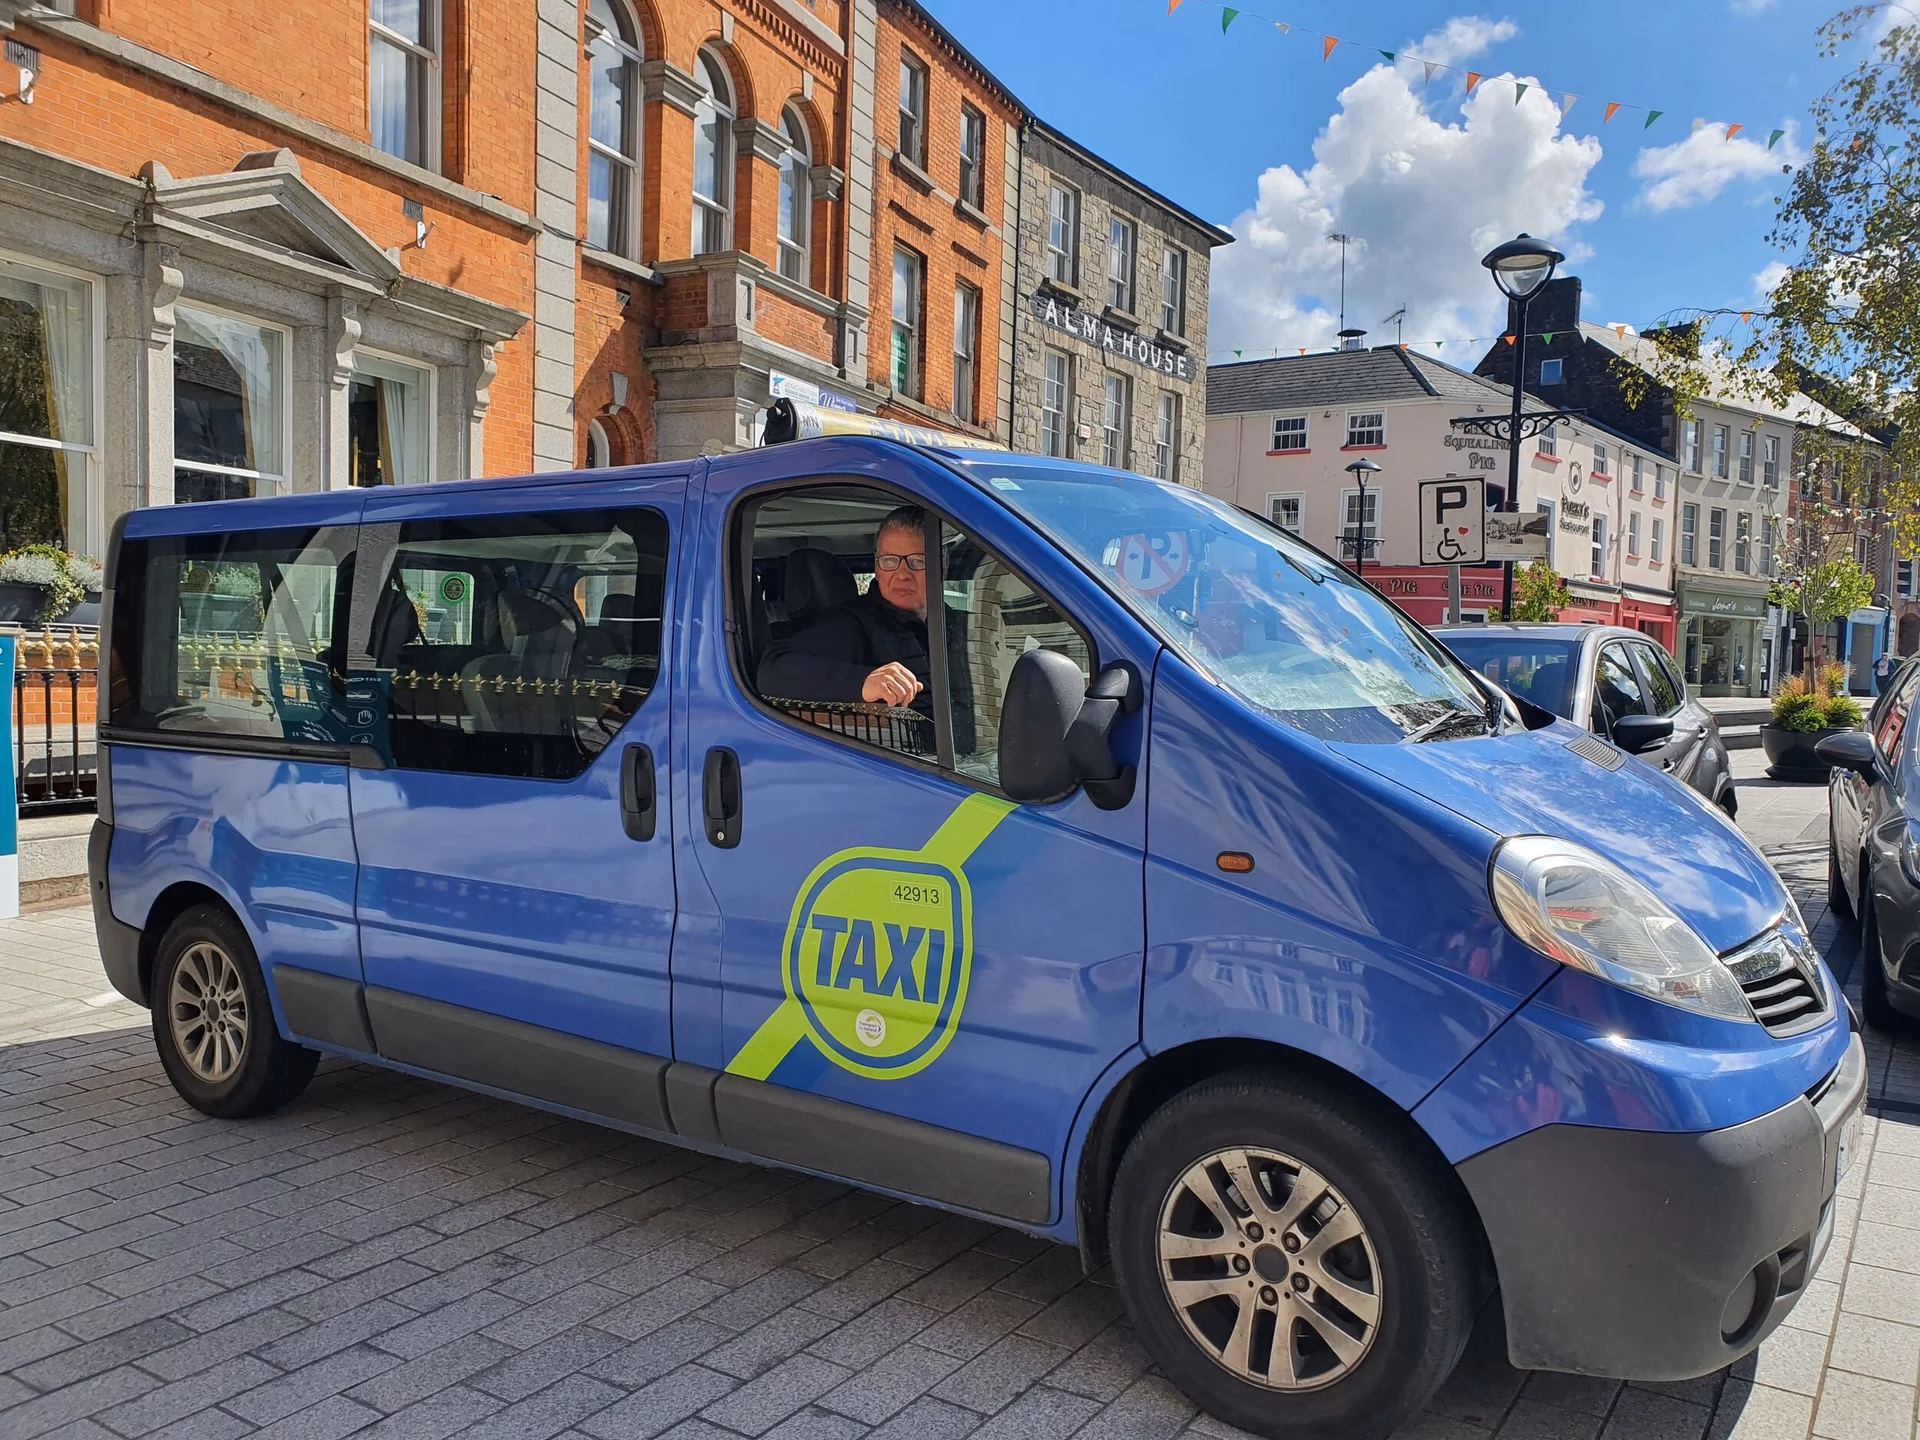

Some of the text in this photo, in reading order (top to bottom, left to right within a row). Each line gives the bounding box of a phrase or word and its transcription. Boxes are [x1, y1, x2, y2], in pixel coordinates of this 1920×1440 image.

[1044, 298, 1188, 378] ALMA HOUSE
[1444, 435, 1512, 451] SQUEALING
[1469, 452, 1496, 470] PIG
[1436, 485, 1467, 524] P
[1389, 578, 1418, 594] PIG
[1474, 583, 1496, 596] PIG
[894, 885, 940, 904] 42913
[812, 913, 945, 1005] TAXI
